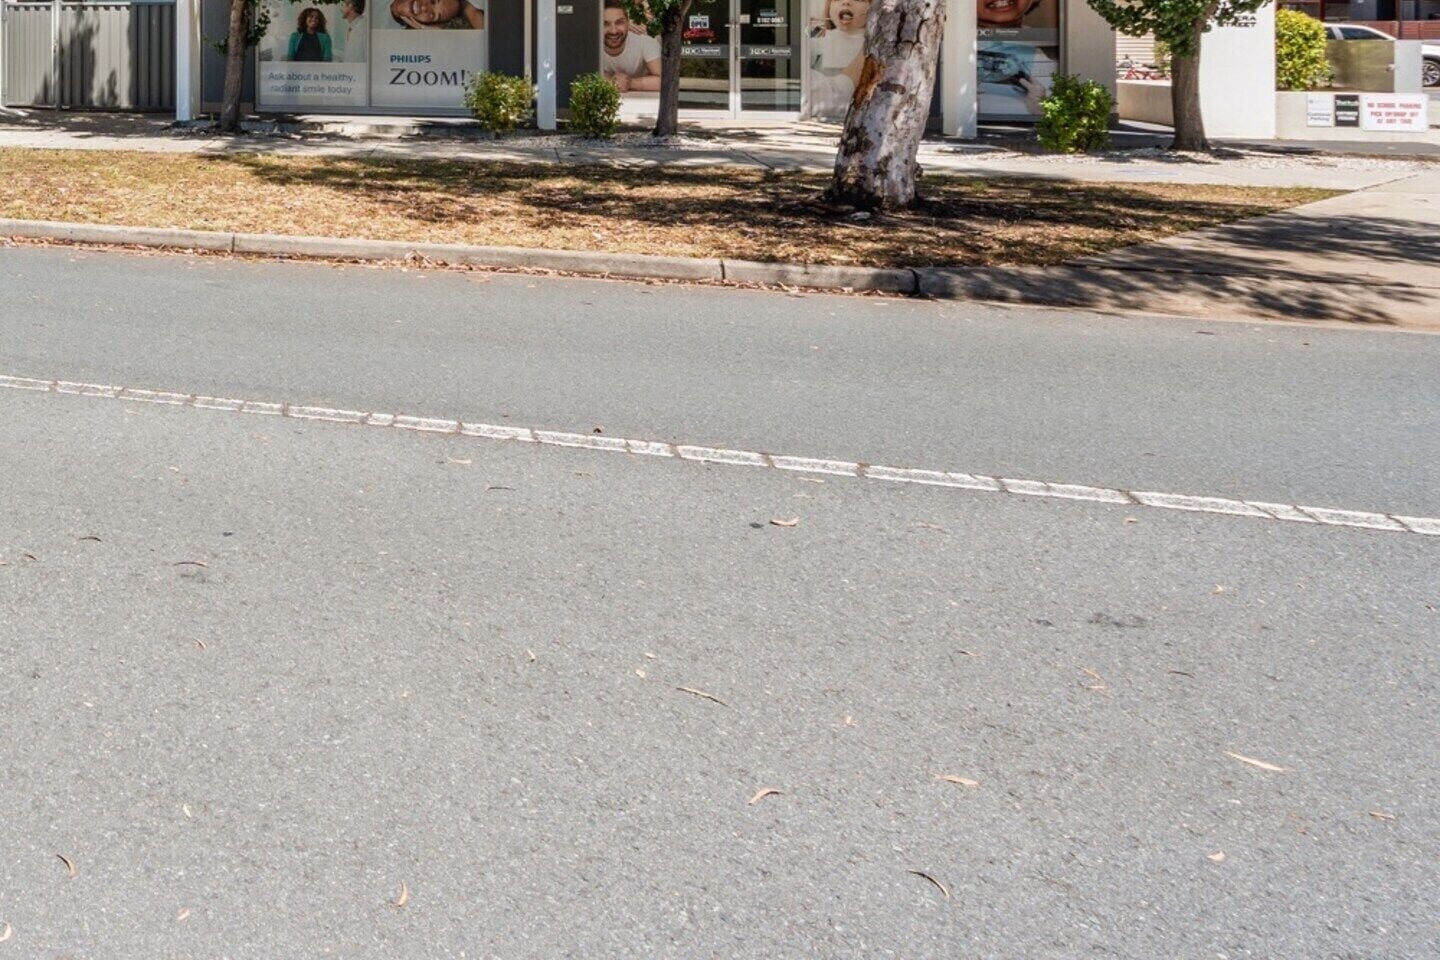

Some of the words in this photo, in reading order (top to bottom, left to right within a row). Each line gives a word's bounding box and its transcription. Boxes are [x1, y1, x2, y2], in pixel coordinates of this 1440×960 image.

[389, 54, 432, 64] PHILIPS
[267, 72, 285, 81] Ask
[286, 72, 312, 81] about
[321, 72, 357, 83] healthy,
[270, 85, 300, 94] radiant
[302, 85, 325, 94] smile
[327, 85, 352, 96] today
